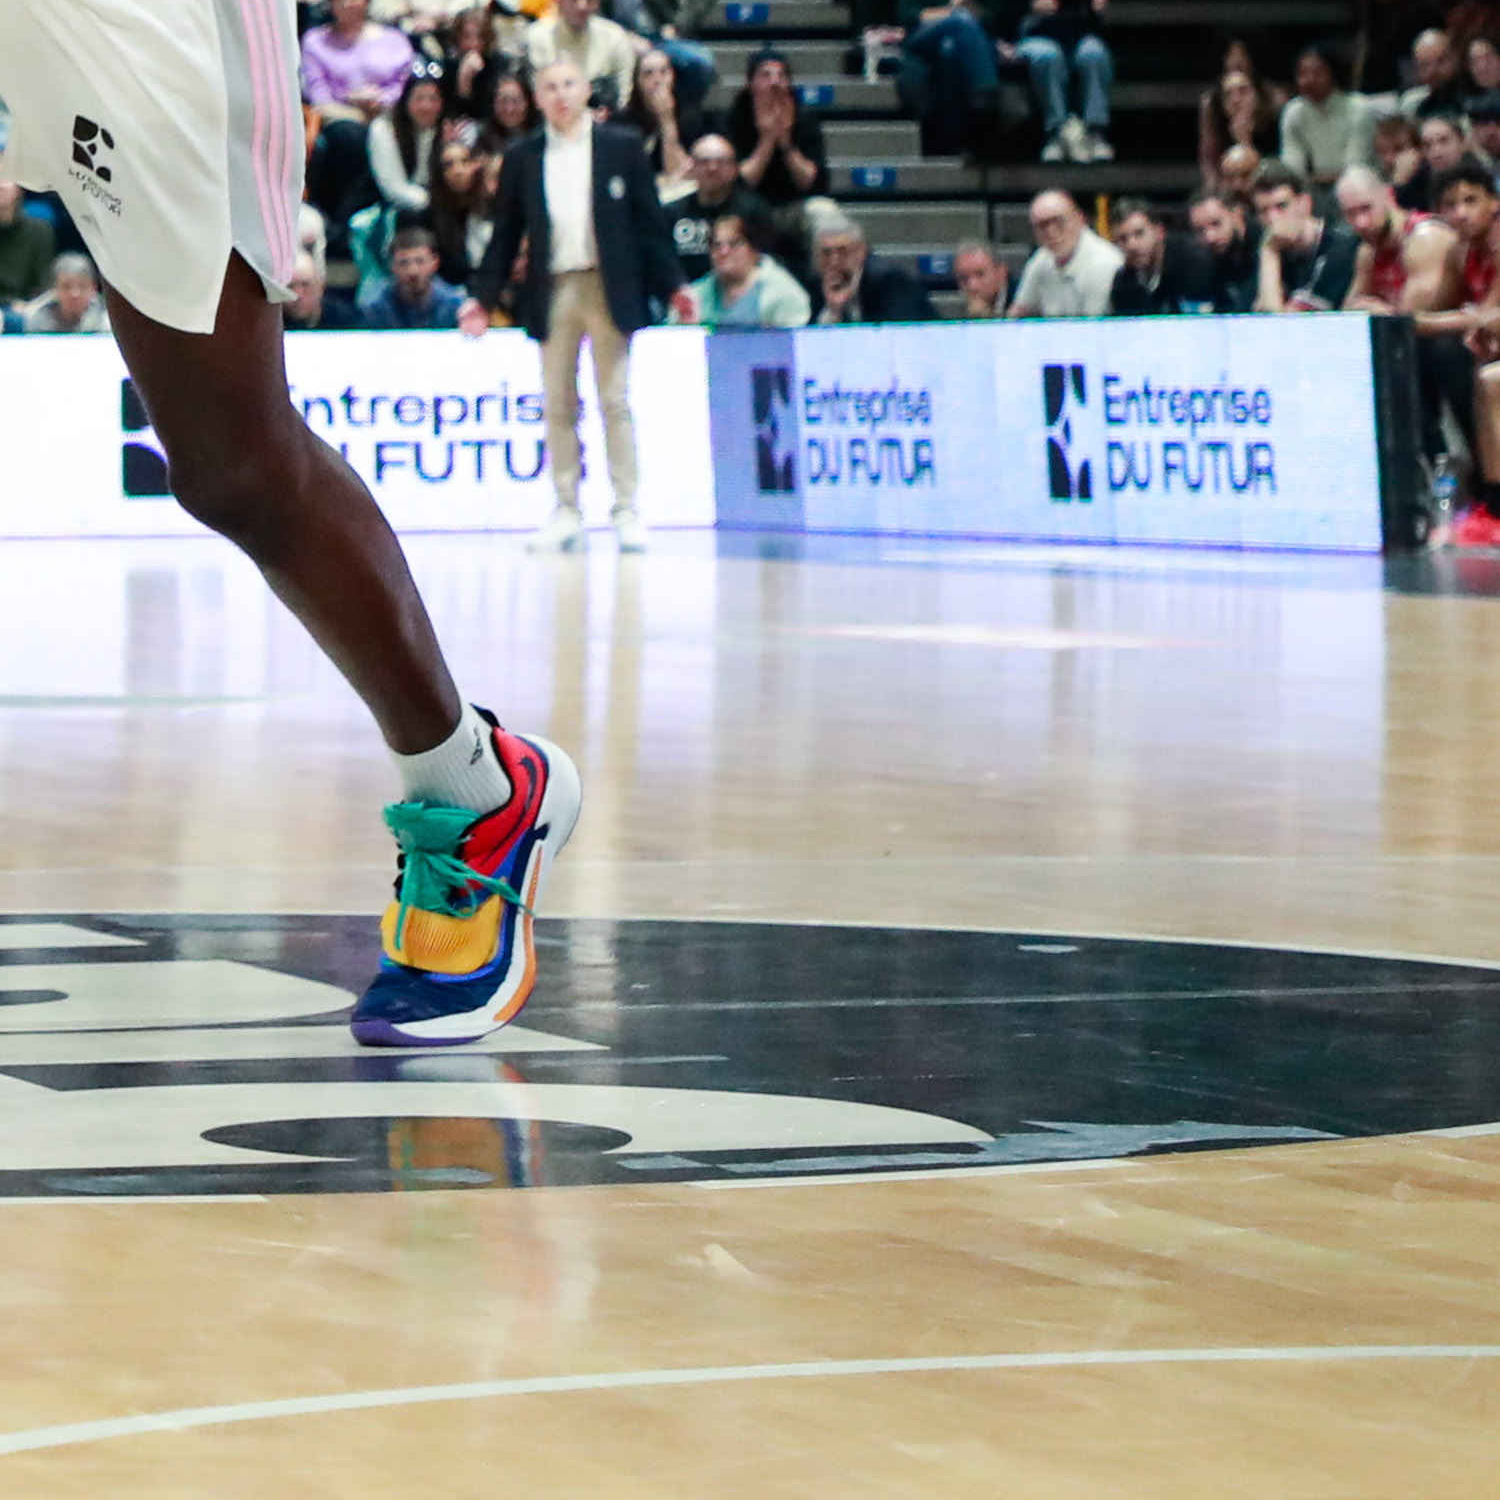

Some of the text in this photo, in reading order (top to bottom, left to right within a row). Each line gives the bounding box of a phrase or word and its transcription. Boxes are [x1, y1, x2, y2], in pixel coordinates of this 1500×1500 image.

[288, 384, 582, 446] ntrepris
[804, 377, 932, 430] Entreprise
[1104, 370, 1272, 436] Entreprise
[374, 438, 582, 484] FUTU
[807, 437, 936, 488] DU FUTUR
[1108, 441, 1278, 495] DU FUTUR
